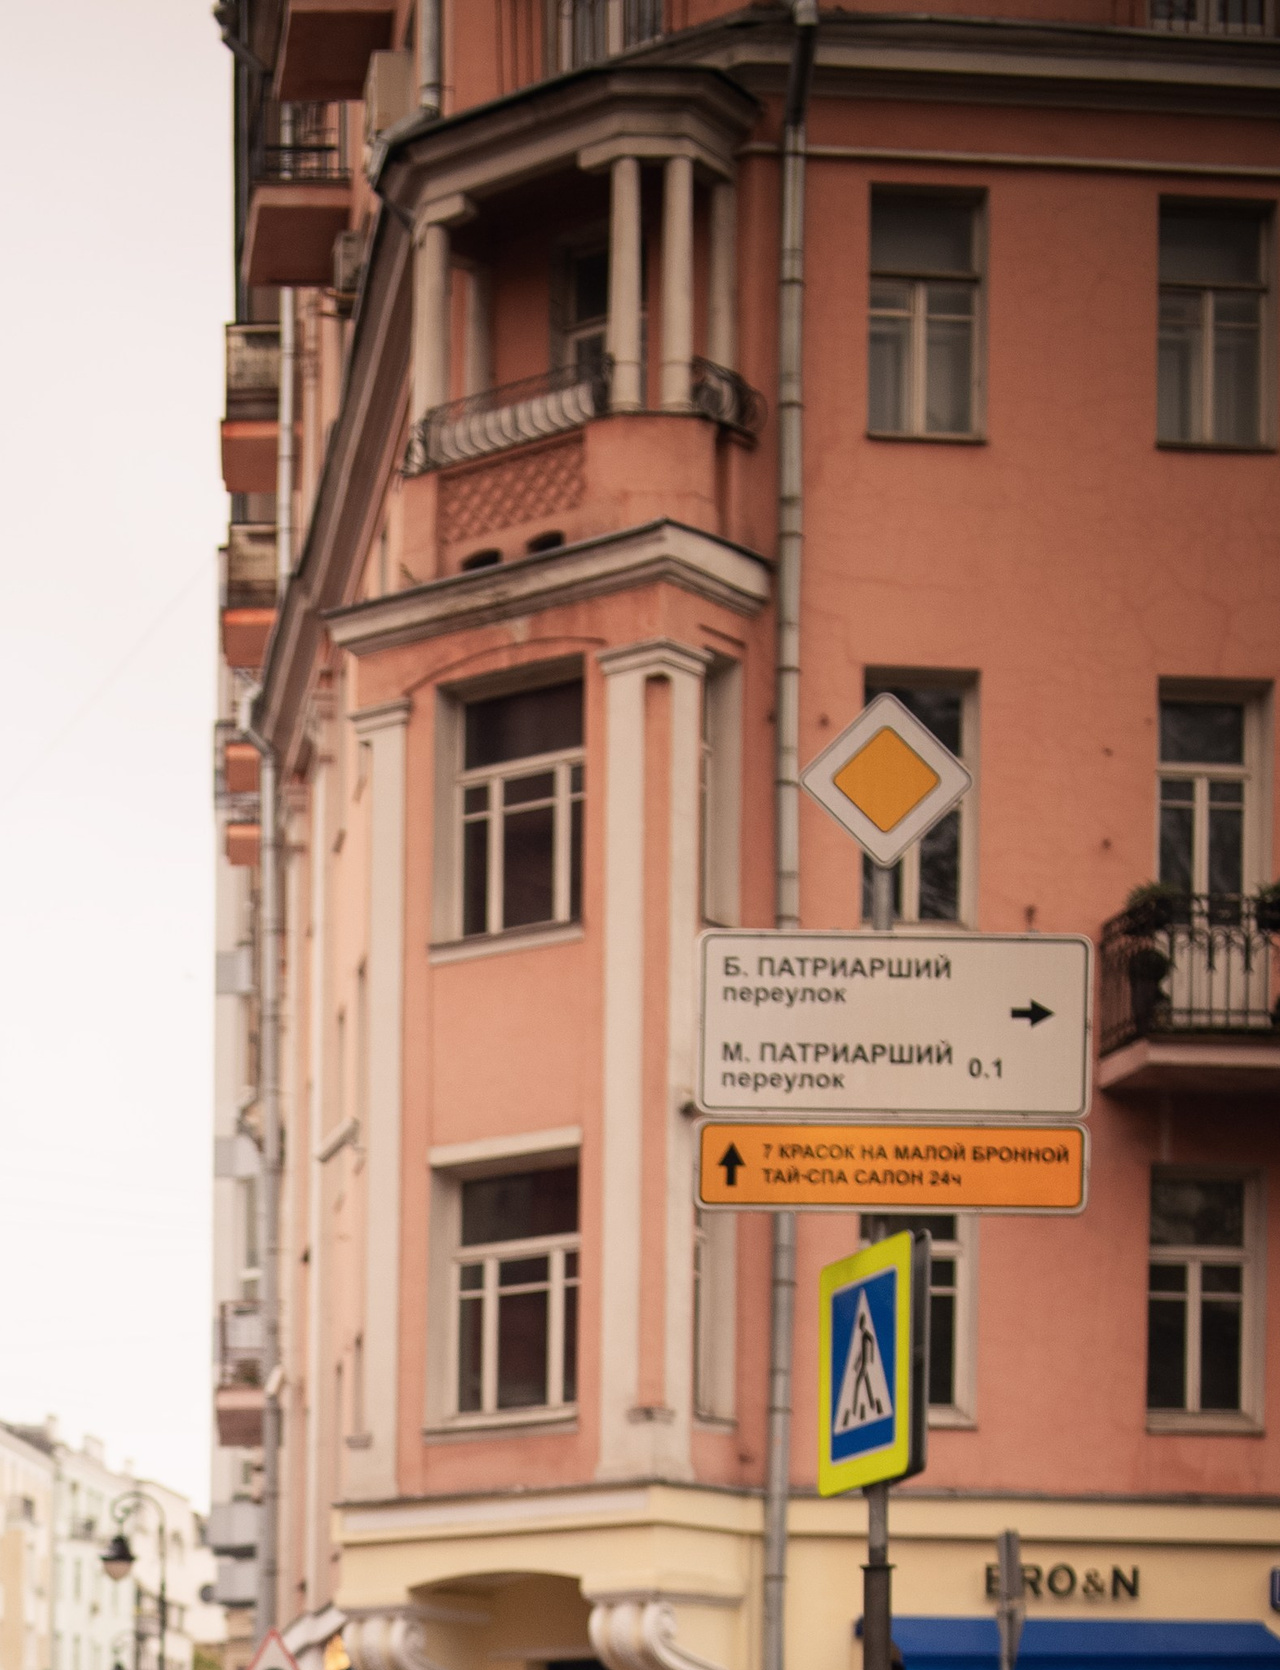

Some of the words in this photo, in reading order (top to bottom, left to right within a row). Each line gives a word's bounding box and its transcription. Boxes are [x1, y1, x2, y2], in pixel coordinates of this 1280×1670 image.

[723, 956, 749, 978] Б.
[758, 953, 952, 979] ПАТРИАРШИЙ
[723, 985, 847, 1007] переулок
[722, 1041, 750, 1063] М.
[760, 1039, 954, 1065] ПАТРИАРШИЙ
[968, 1058, 1003, 1079] 0.1
[721, 1070, 846, 1093] переулок
[763, 1143, 773, 1159] 7
[779, 1143, 855, 1160] КРАСОК
[861, 1144, 888, 1160] НА
[894, 1143, 966, 1162] МАЛОЙ
[972, 1143, 1070, 1163] БРОННОЙ
[762, 1166, 849, 1185] ТАЙ-СПА
[854, 1168, 924, 1186] САЛОН
